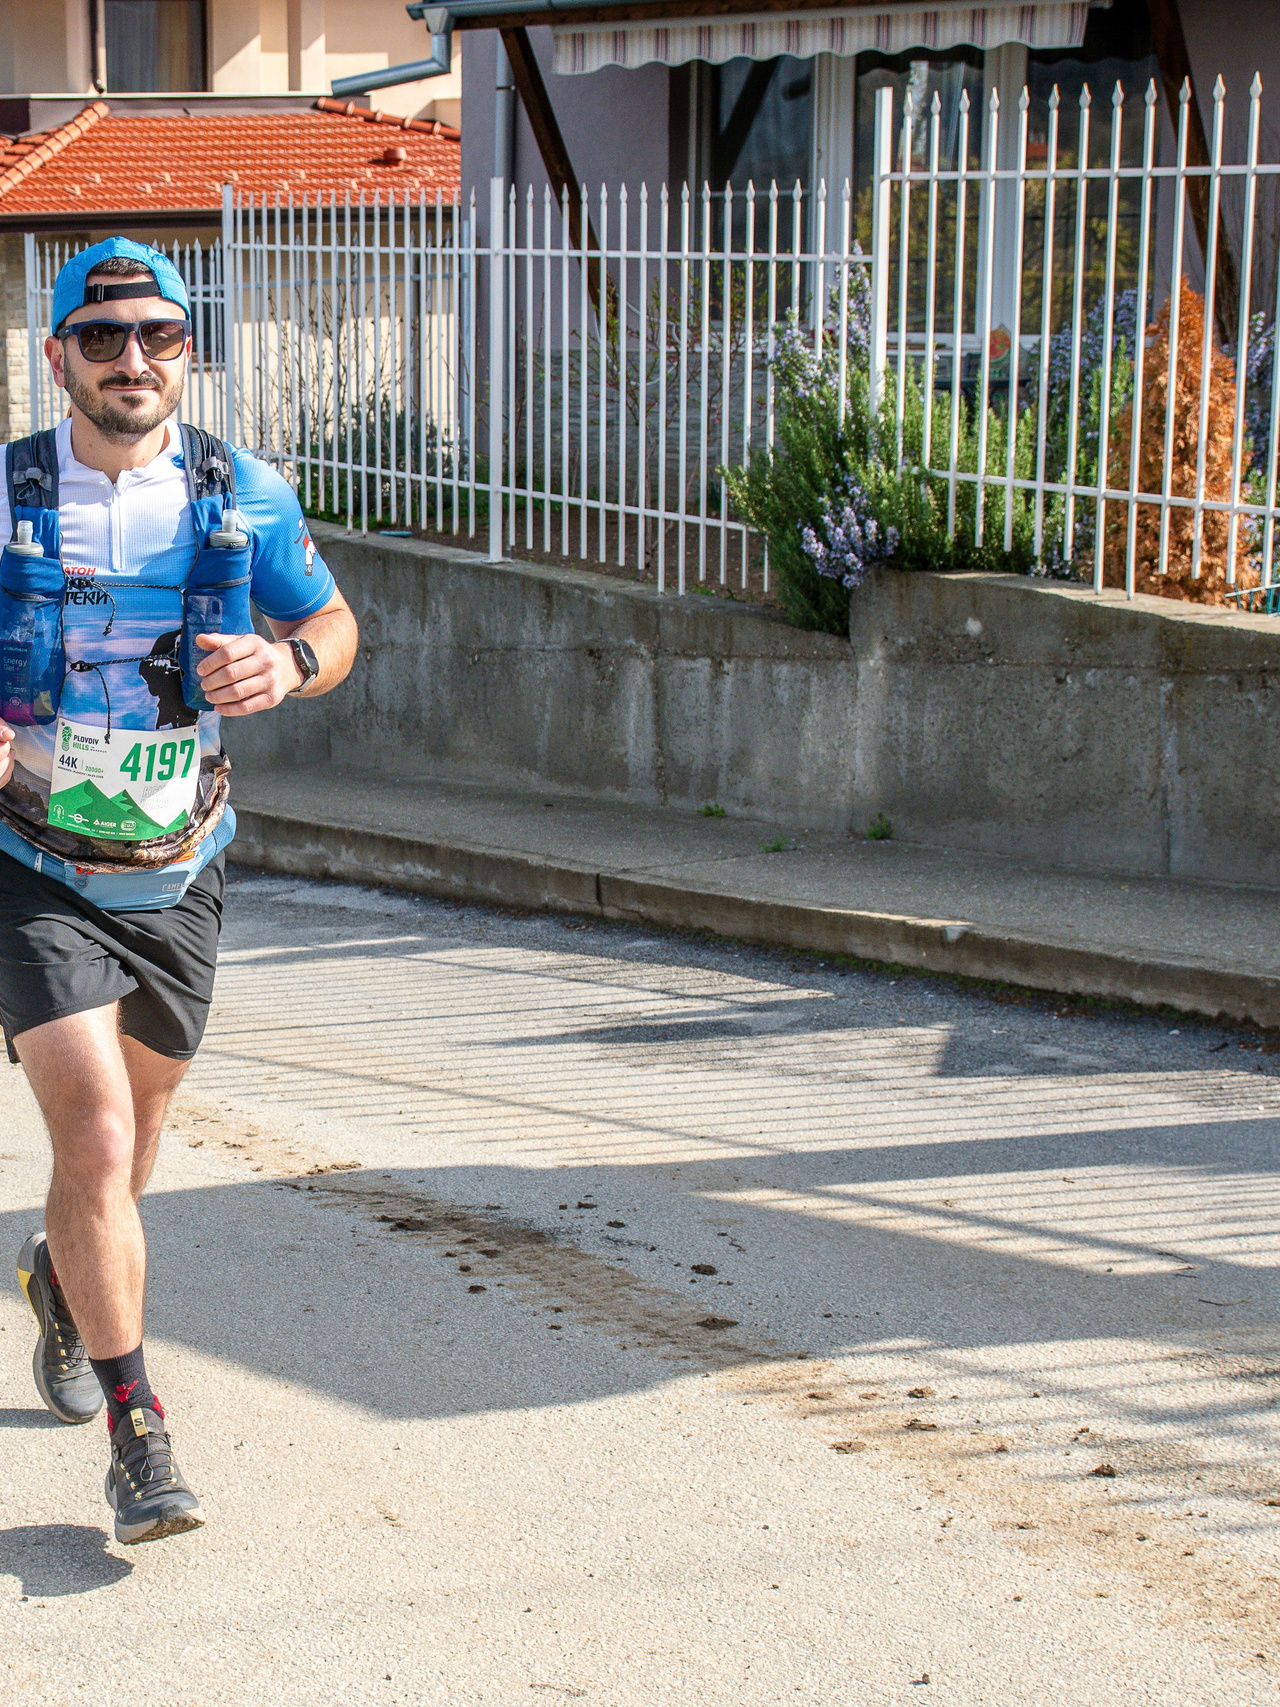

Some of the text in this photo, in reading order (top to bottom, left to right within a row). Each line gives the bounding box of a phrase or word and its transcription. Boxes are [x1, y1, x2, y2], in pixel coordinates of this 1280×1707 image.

[3, 656, 28, 667] Energy
[73, 734, 99, 745] PLOVDIV
[72, 742, 90, 751] HILLS
[59, 754, 78, 769] 44K
[119, 738, 196, 782] 4197
